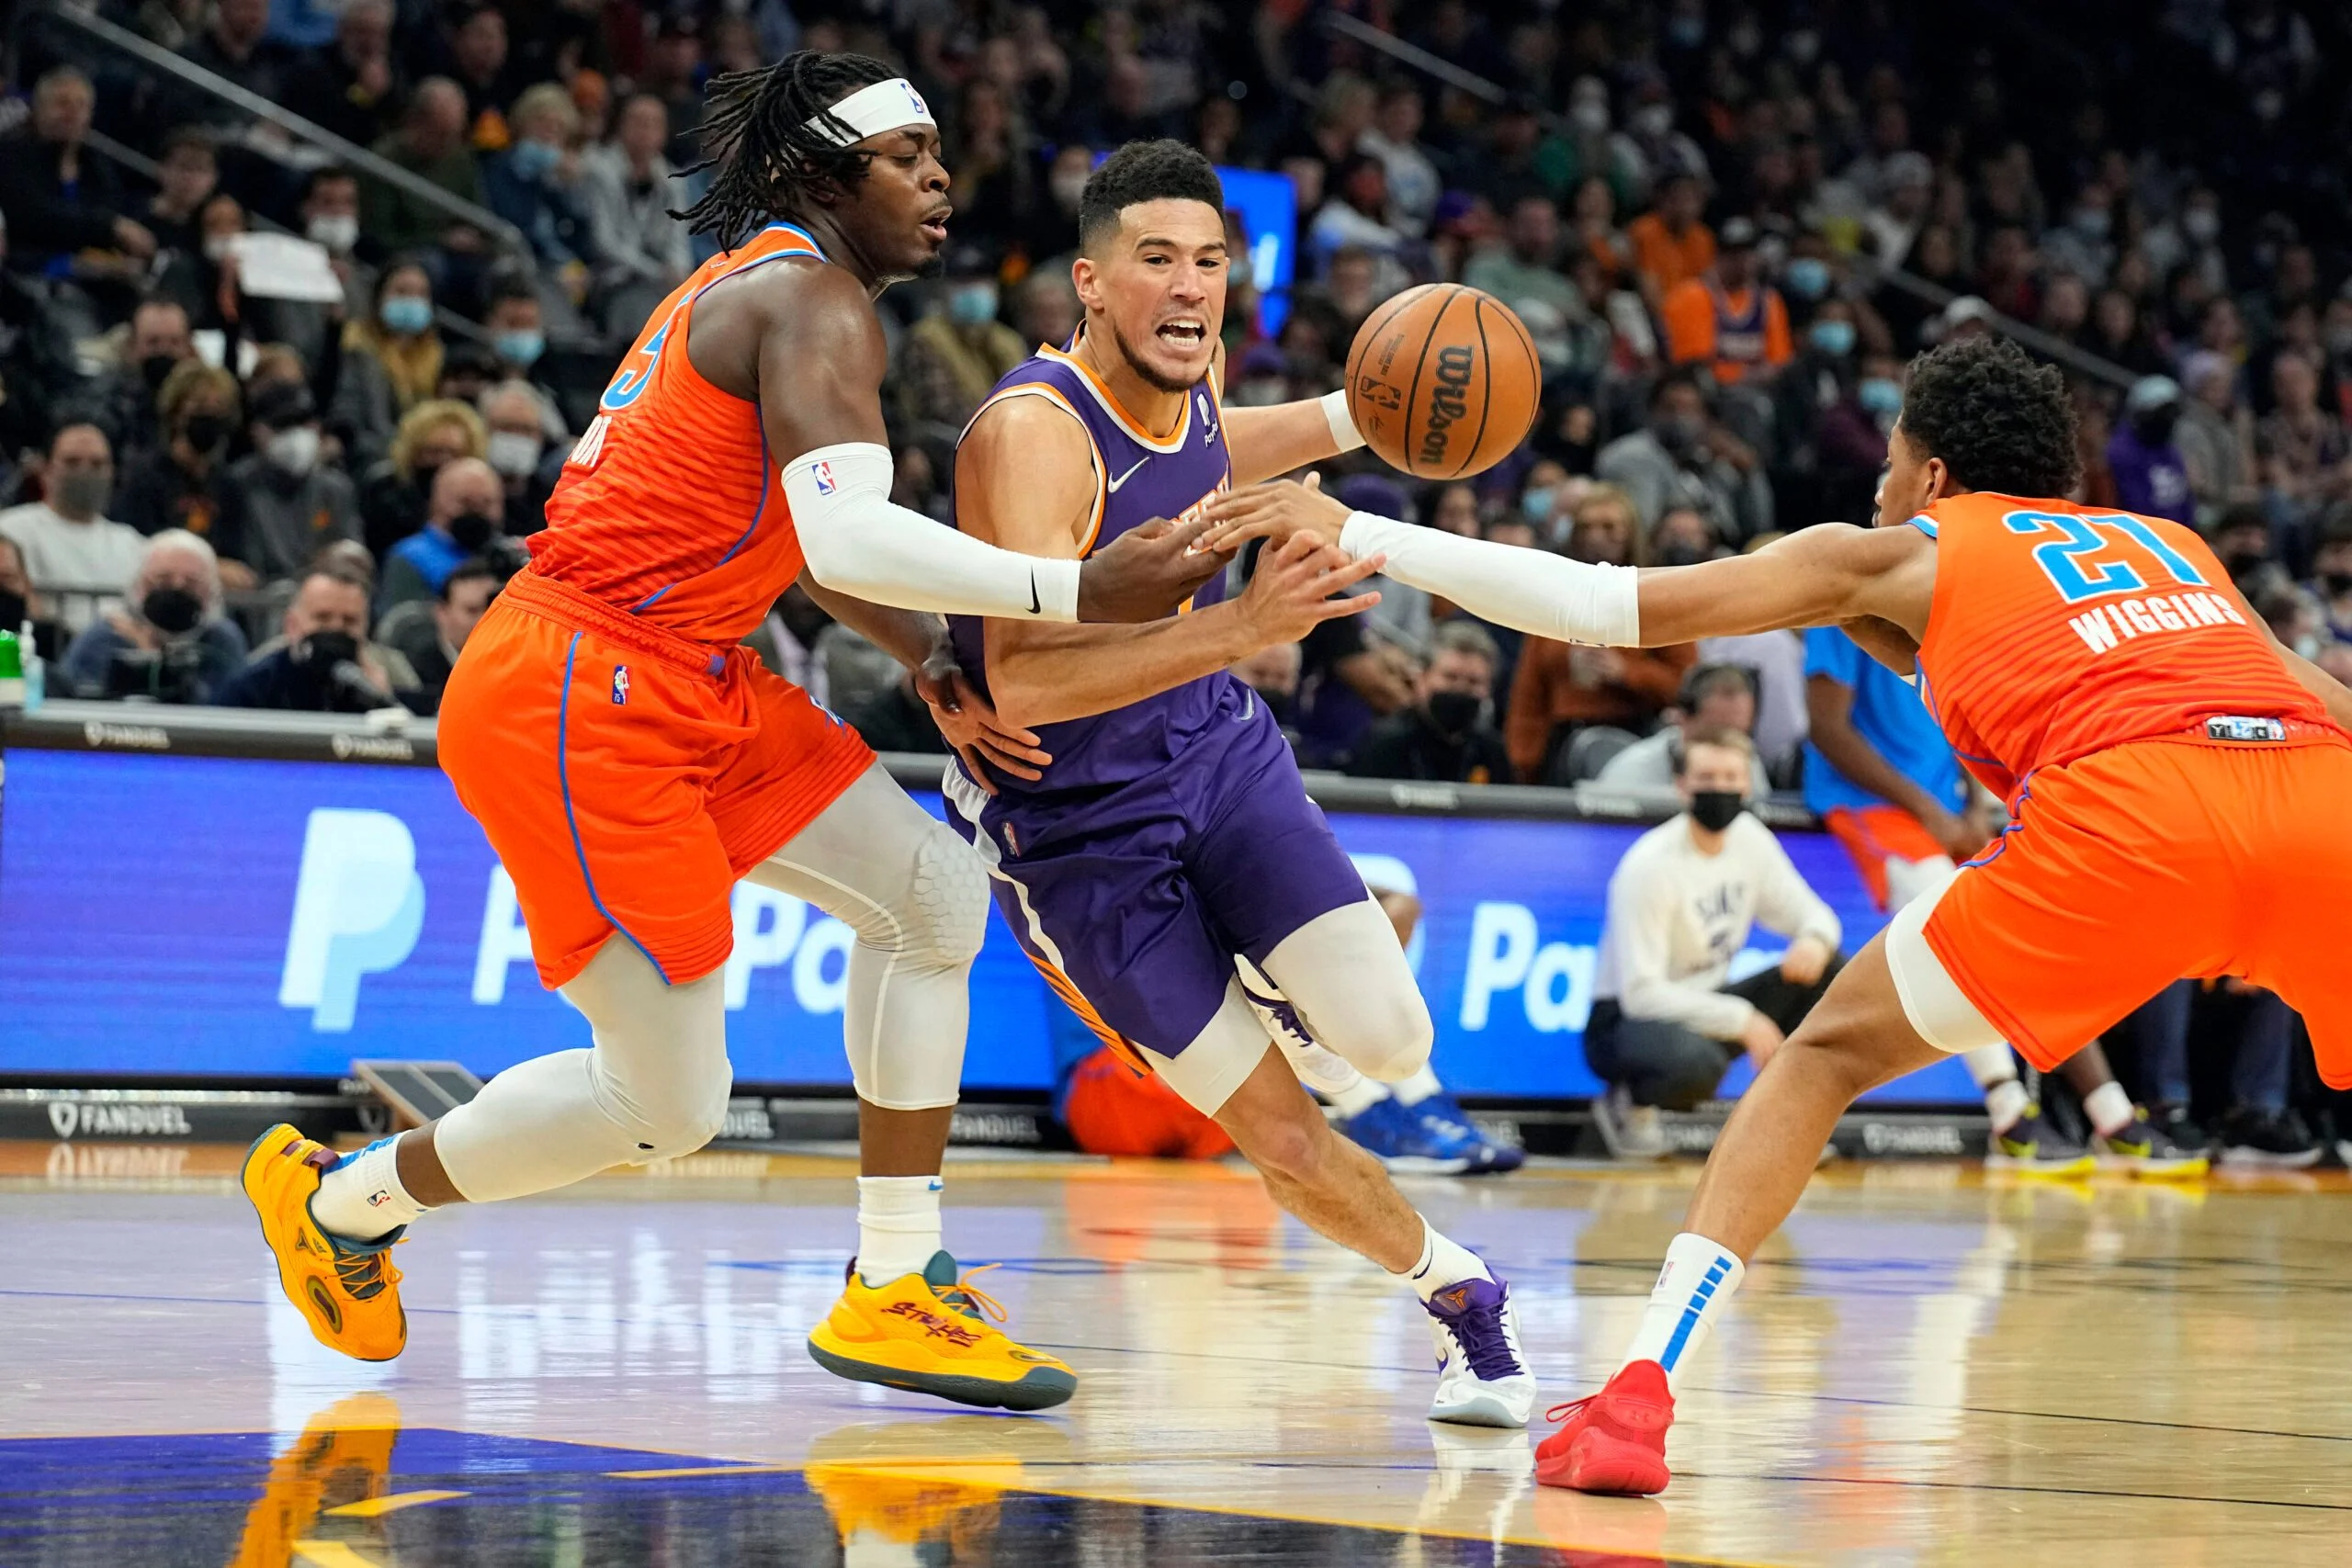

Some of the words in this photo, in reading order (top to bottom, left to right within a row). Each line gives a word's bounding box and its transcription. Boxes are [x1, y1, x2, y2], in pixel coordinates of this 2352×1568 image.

[1419, 344, 1475, 464] Wilson
[2001, 510, 2212, 605] 21
[2068, 592, 2247, 655] WIGGINS
[80, 1105, 192, 1135] FANDUEL
